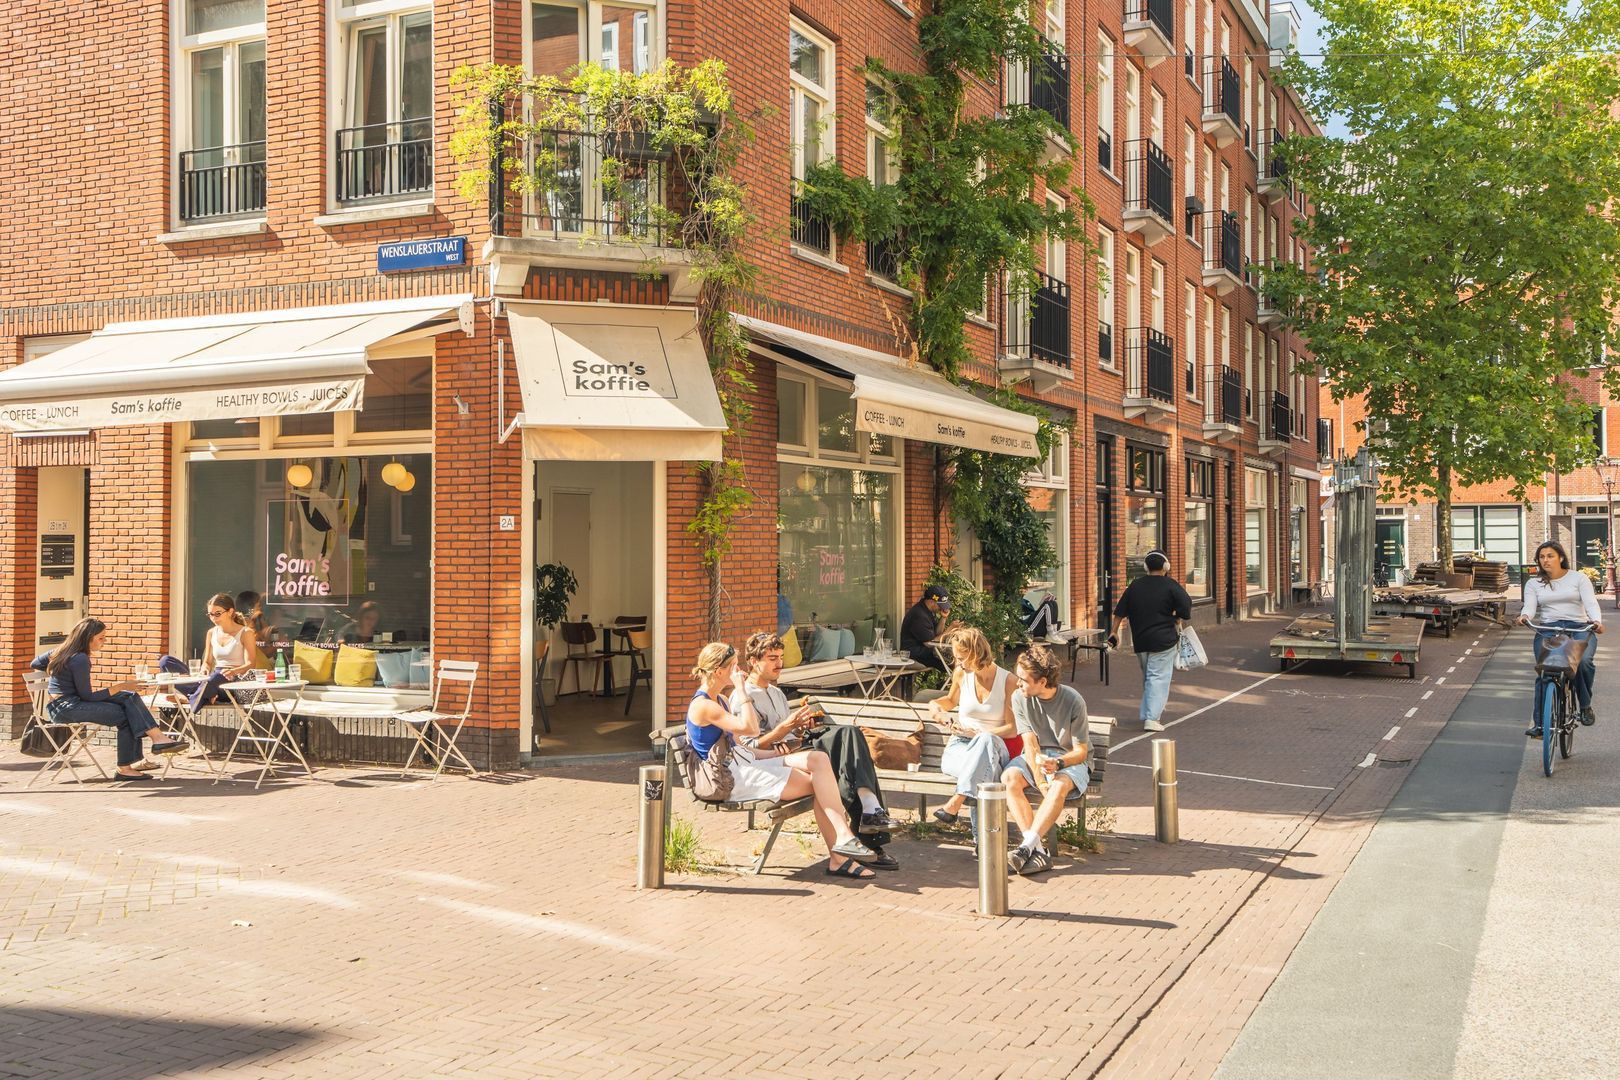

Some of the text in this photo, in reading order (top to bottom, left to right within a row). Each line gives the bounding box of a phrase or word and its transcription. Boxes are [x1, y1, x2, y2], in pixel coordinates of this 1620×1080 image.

[381, 240, 458, 258] WENSLAUERSTRAAT
[445, 253, 459, 261] WEST
[572, 360, 646, 376] Sam's
[575, 375, 650, 391] koffie
[216, 393, 260, 408] HEALTHY
[262, 391, 299, 405] BOWLS
[309, 387, 348, 401] JUICES
[1, 408, 37, 421] COFFEE
[46, 406, 79, 419] LUNCH
[111, 398, 182, 415] Sam's koffie
[864, 410, 885, 424] COFFEE
[888, 415, 905, 429] LUNCH
[937, 423, 966, 438] Sam's koffie
[501, 518, 513, 528] 2A
[275, 552, 330, 574] Sam's
[820, 549, 845, 566] Sam's
[820, 567, 845, 585] koffie
[274, 574, 330, 596] koffie
